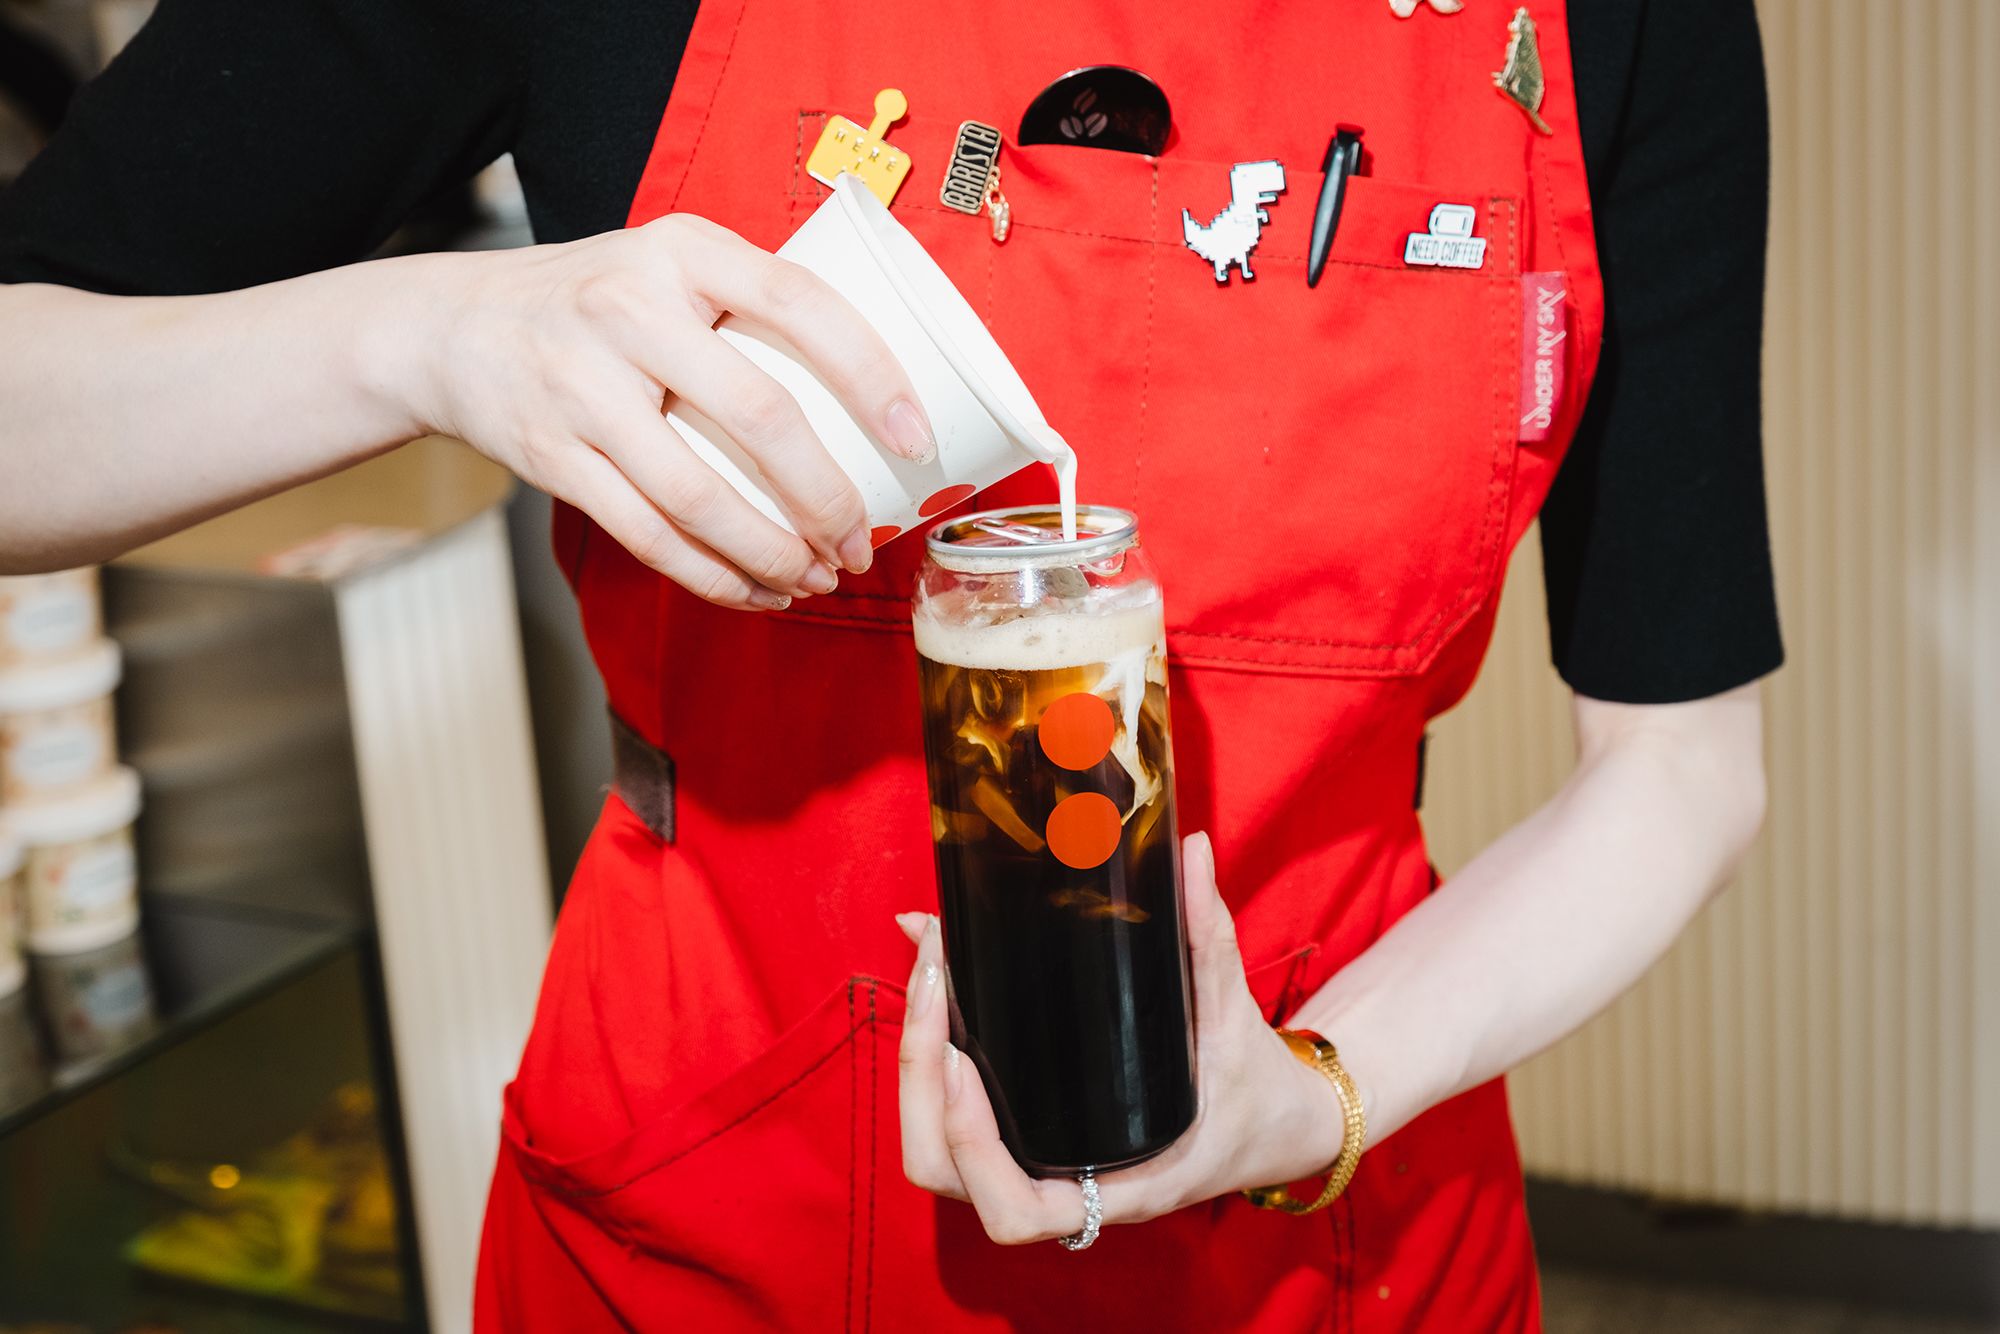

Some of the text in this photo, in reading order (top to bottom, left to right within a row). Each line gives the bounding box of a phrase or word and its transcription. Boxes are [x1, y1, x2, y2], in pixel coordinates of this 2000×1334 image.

[834, 127, 897, 173] HERE
[945, 123, 998, 210] BARISTA
[1411, 238, 1483, 264] NEED COFFEE
[1536, 286, 1567, 325] SKY
[1521, 358, 1553, 429] UNDER
